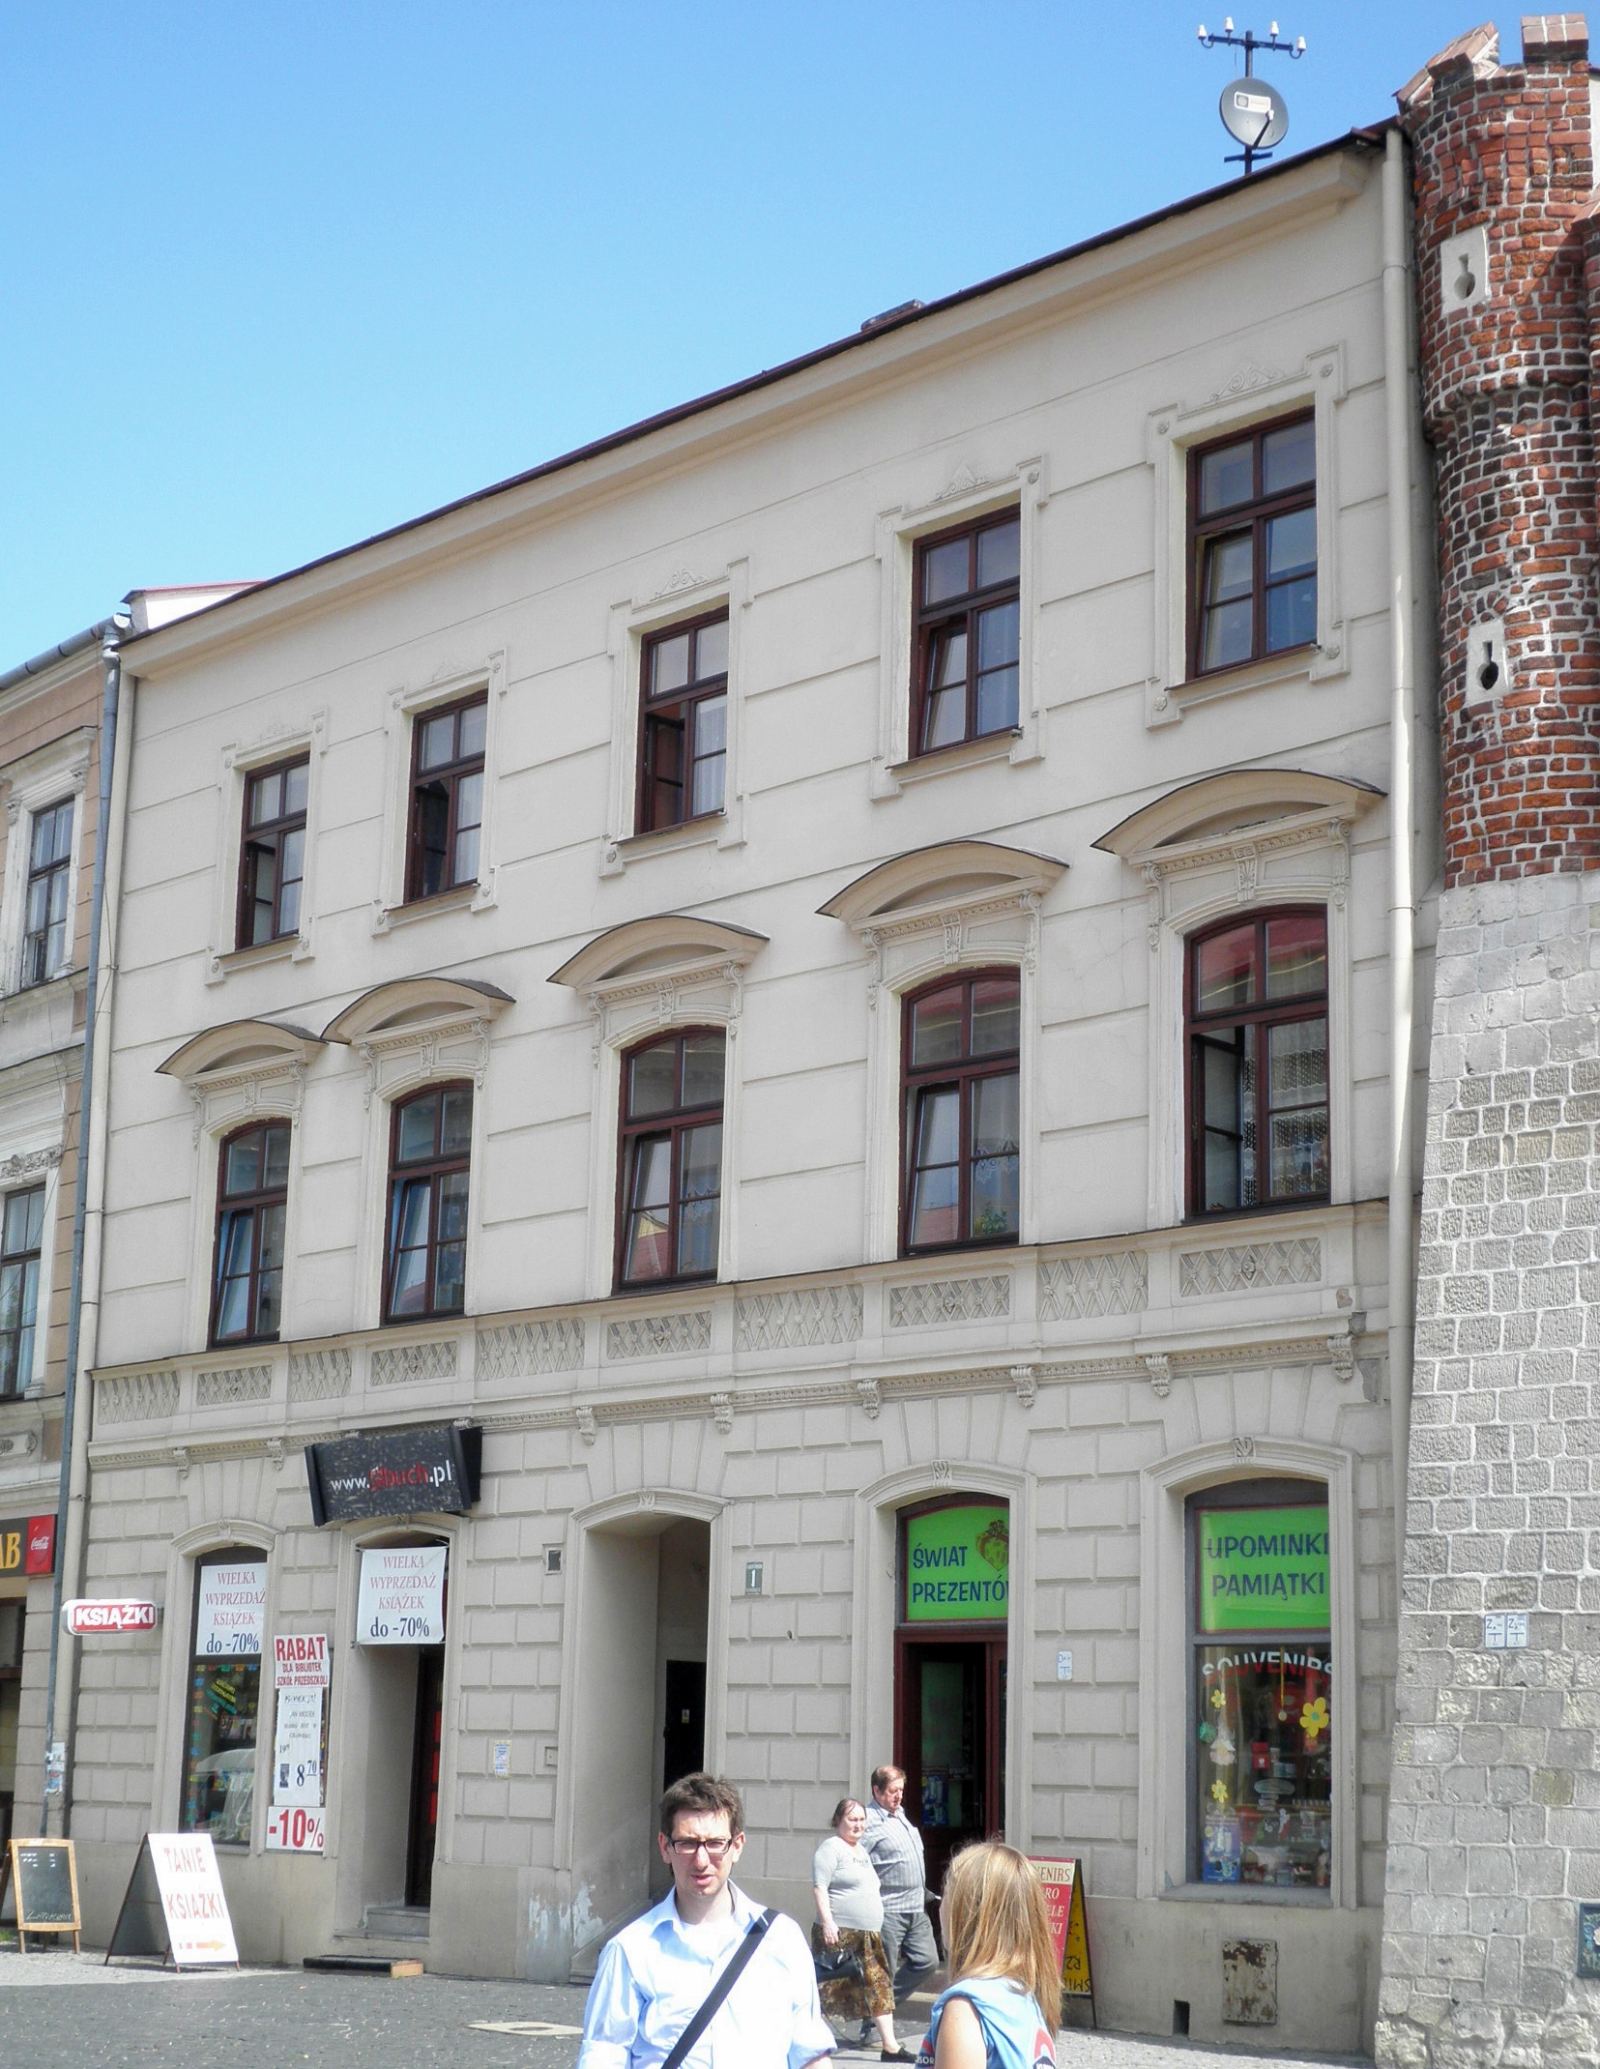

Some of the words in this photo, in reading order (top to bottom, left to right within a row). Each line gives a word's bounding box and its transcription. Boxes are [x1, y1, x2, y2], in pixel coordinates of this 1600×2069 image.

[913, 1542, 968, 1569] ŚWIAT
[1208, 1533, 1329, 1558] UPOMINKI
[383, 1556, 425, 1569] WIELKA
[217, 1571, 256, 1584] WIELKA
[370, 1572, 436, 1589] WYPRZEDAŻ
[912, 1575, 1008, 1603] PREZENTÓ
[1213, 1572, 1325, 1601] PAMIĄTKI
[76, 1604, 154, 1629] KSIĄŻKI
[370, 1617, 389, 1637] do
[392, 1617, 430, 1637] -70%
[206, 1633, 222, 1653] do
[225, 1632, 259, 1653] -70%
[276, 1636, 325, 1661] RABAT
[269, 1808, 324, 1849] -10%
[164, 1847, 206, 1872] TANIE
